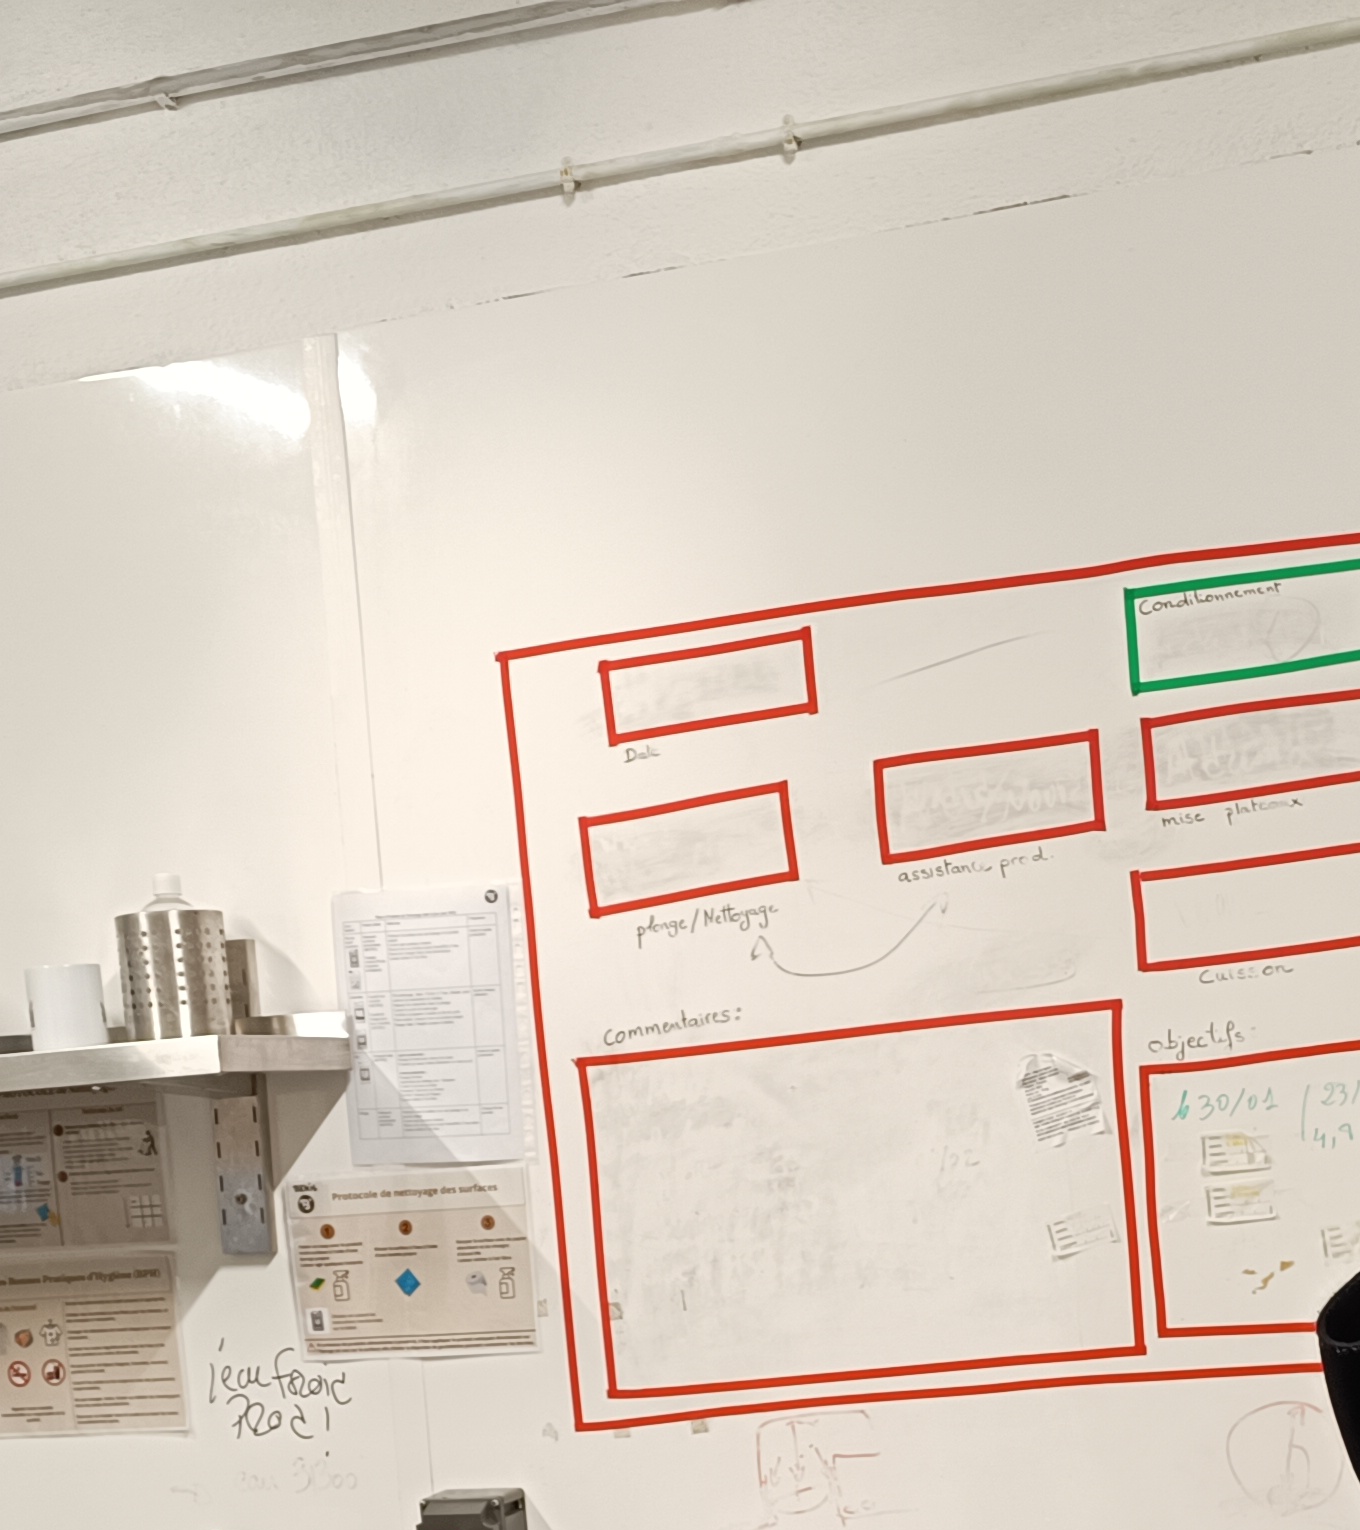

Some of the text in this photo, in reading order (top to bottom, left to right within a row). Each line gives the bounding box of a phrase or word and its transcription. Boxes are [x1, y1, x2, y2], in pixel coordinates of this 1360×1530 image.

[1139, 581, 1282, 615] Conditionnement
[1198, 1087, 1279, 1121] 30/01
[380, 1189, 391, 1199] de
[440, 1185, 456, 1195] des
